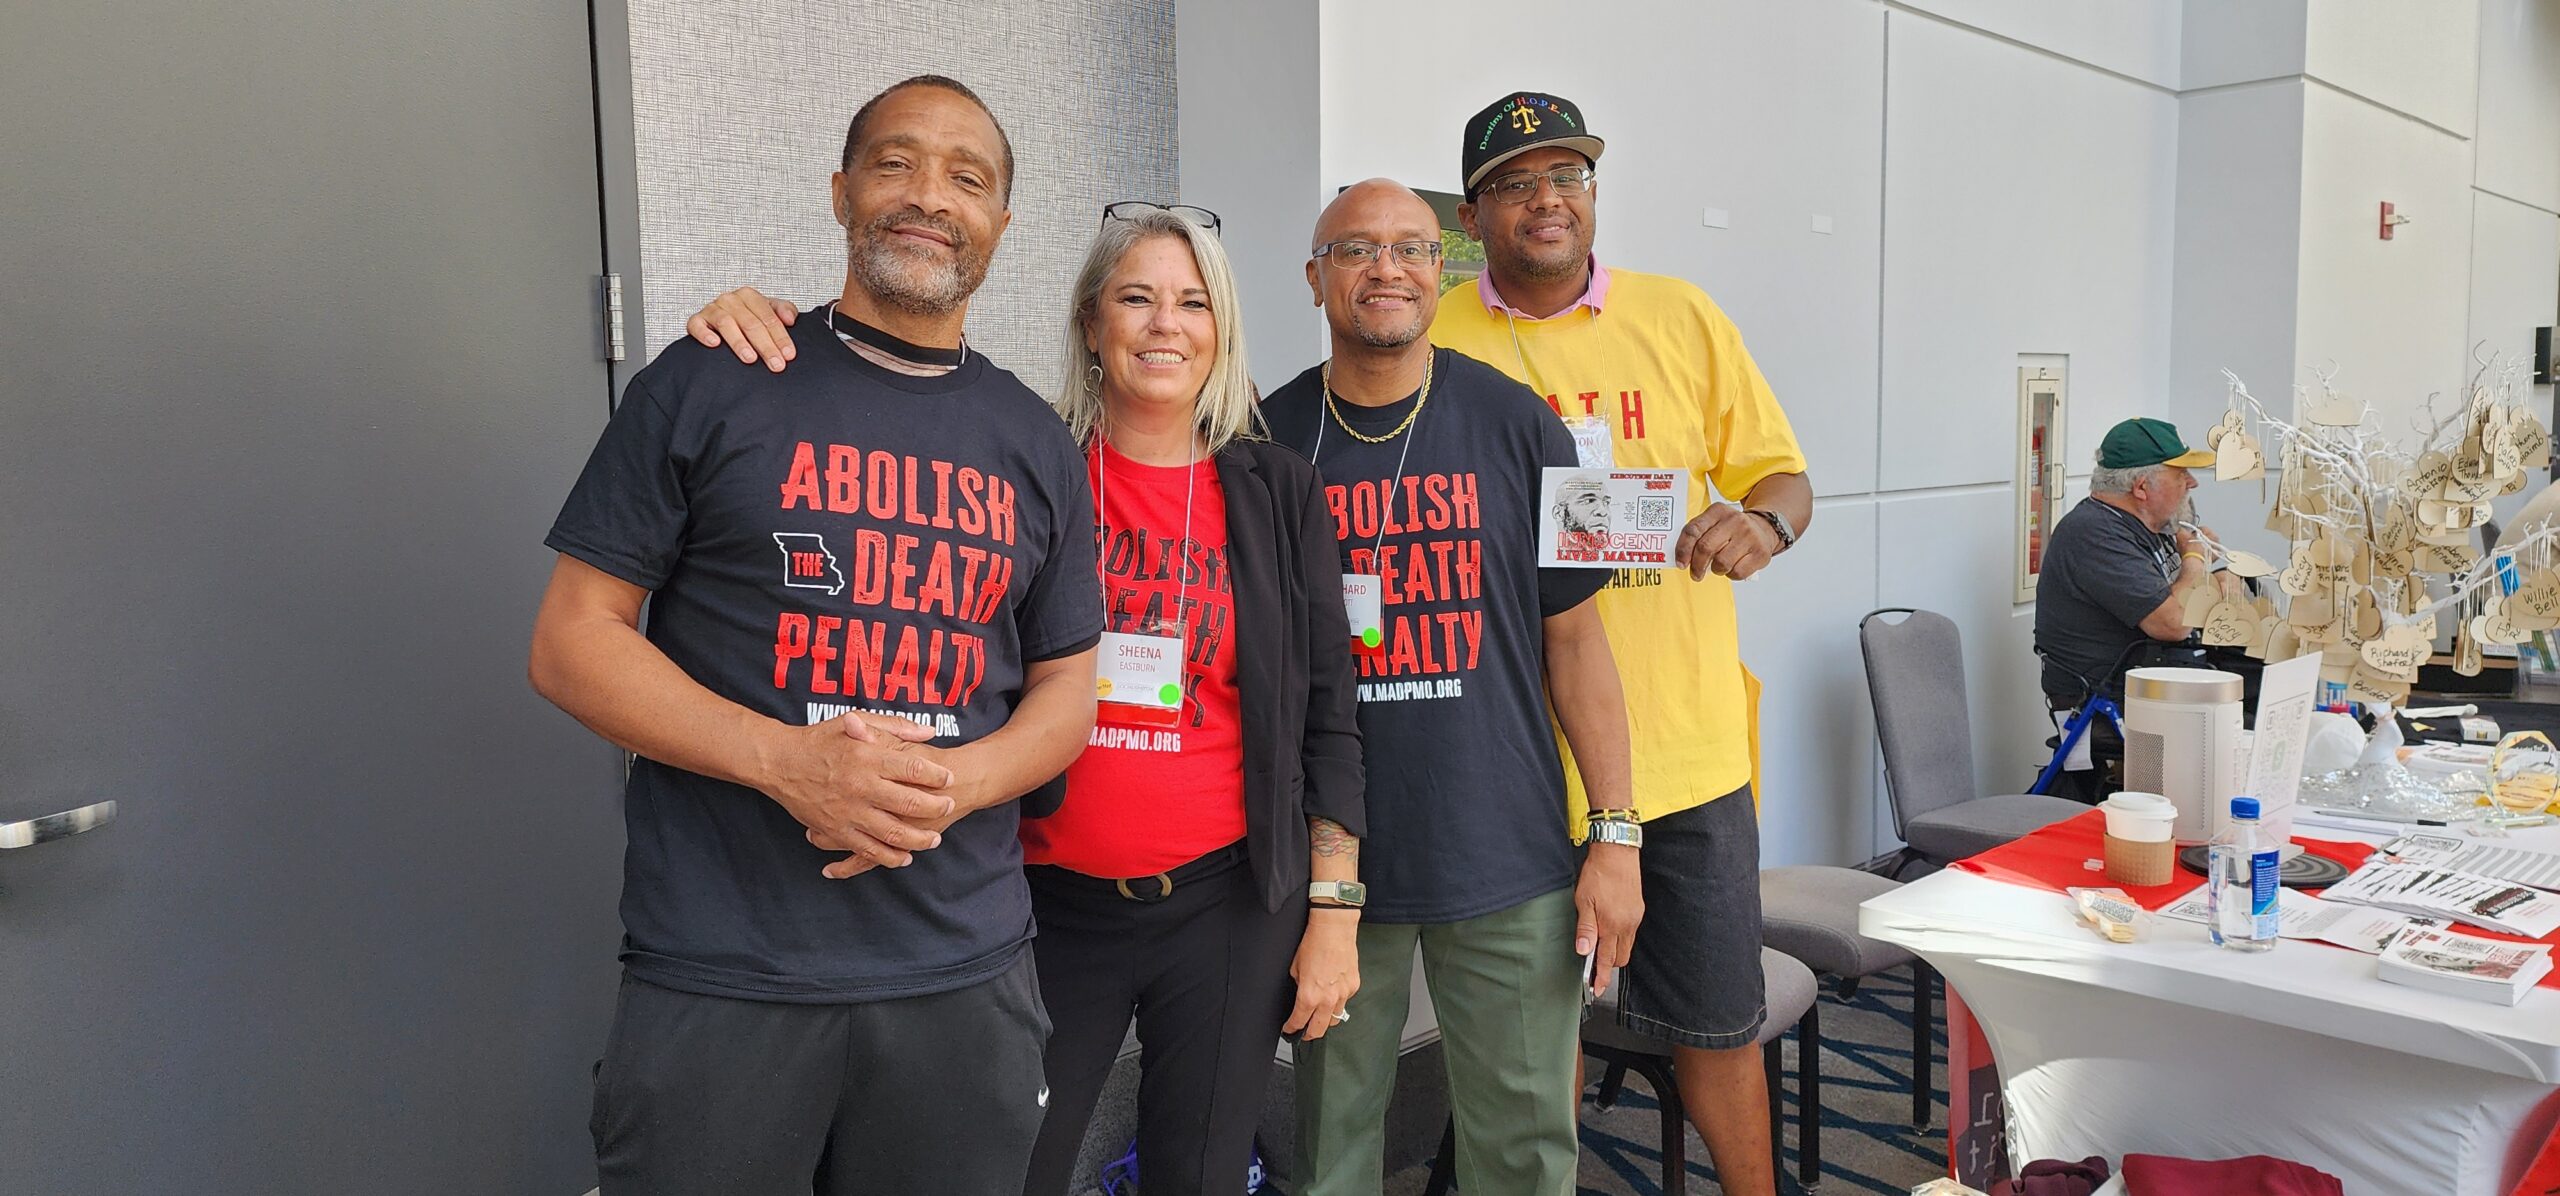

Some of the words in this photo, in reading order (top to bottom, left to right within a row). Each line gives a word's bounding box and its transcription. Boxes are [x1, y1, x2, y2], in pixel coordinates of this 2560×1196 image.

[1479, 112, 1504, 150] Destiny
[1503, 99, 1516, 113] Of
[2406, 463, 2448, 489] Antonio
[2414, 473, 2449, 498] Jackson
[780, 441, 1015, 546] ABOLISH
[1557, 531, 1667, 550] INNOCENT
[792, 551, 824, 577] THE
[1556, 549, 1600, 562] LIVES
[1602, 550, 1667, 563] MATTER
[853, 528, 1012, 624] DEATH
[2287, 555, 2313, 589] Percy
[2523, 586, 2558, 605] Willie
[2534, 596, 2560, 616] Bell
[1118, 644, 1162, 660] SHEENA
[2370, 646, 2409, 659] Richard
[1119, 661, 1156, 673] EASTBURN
